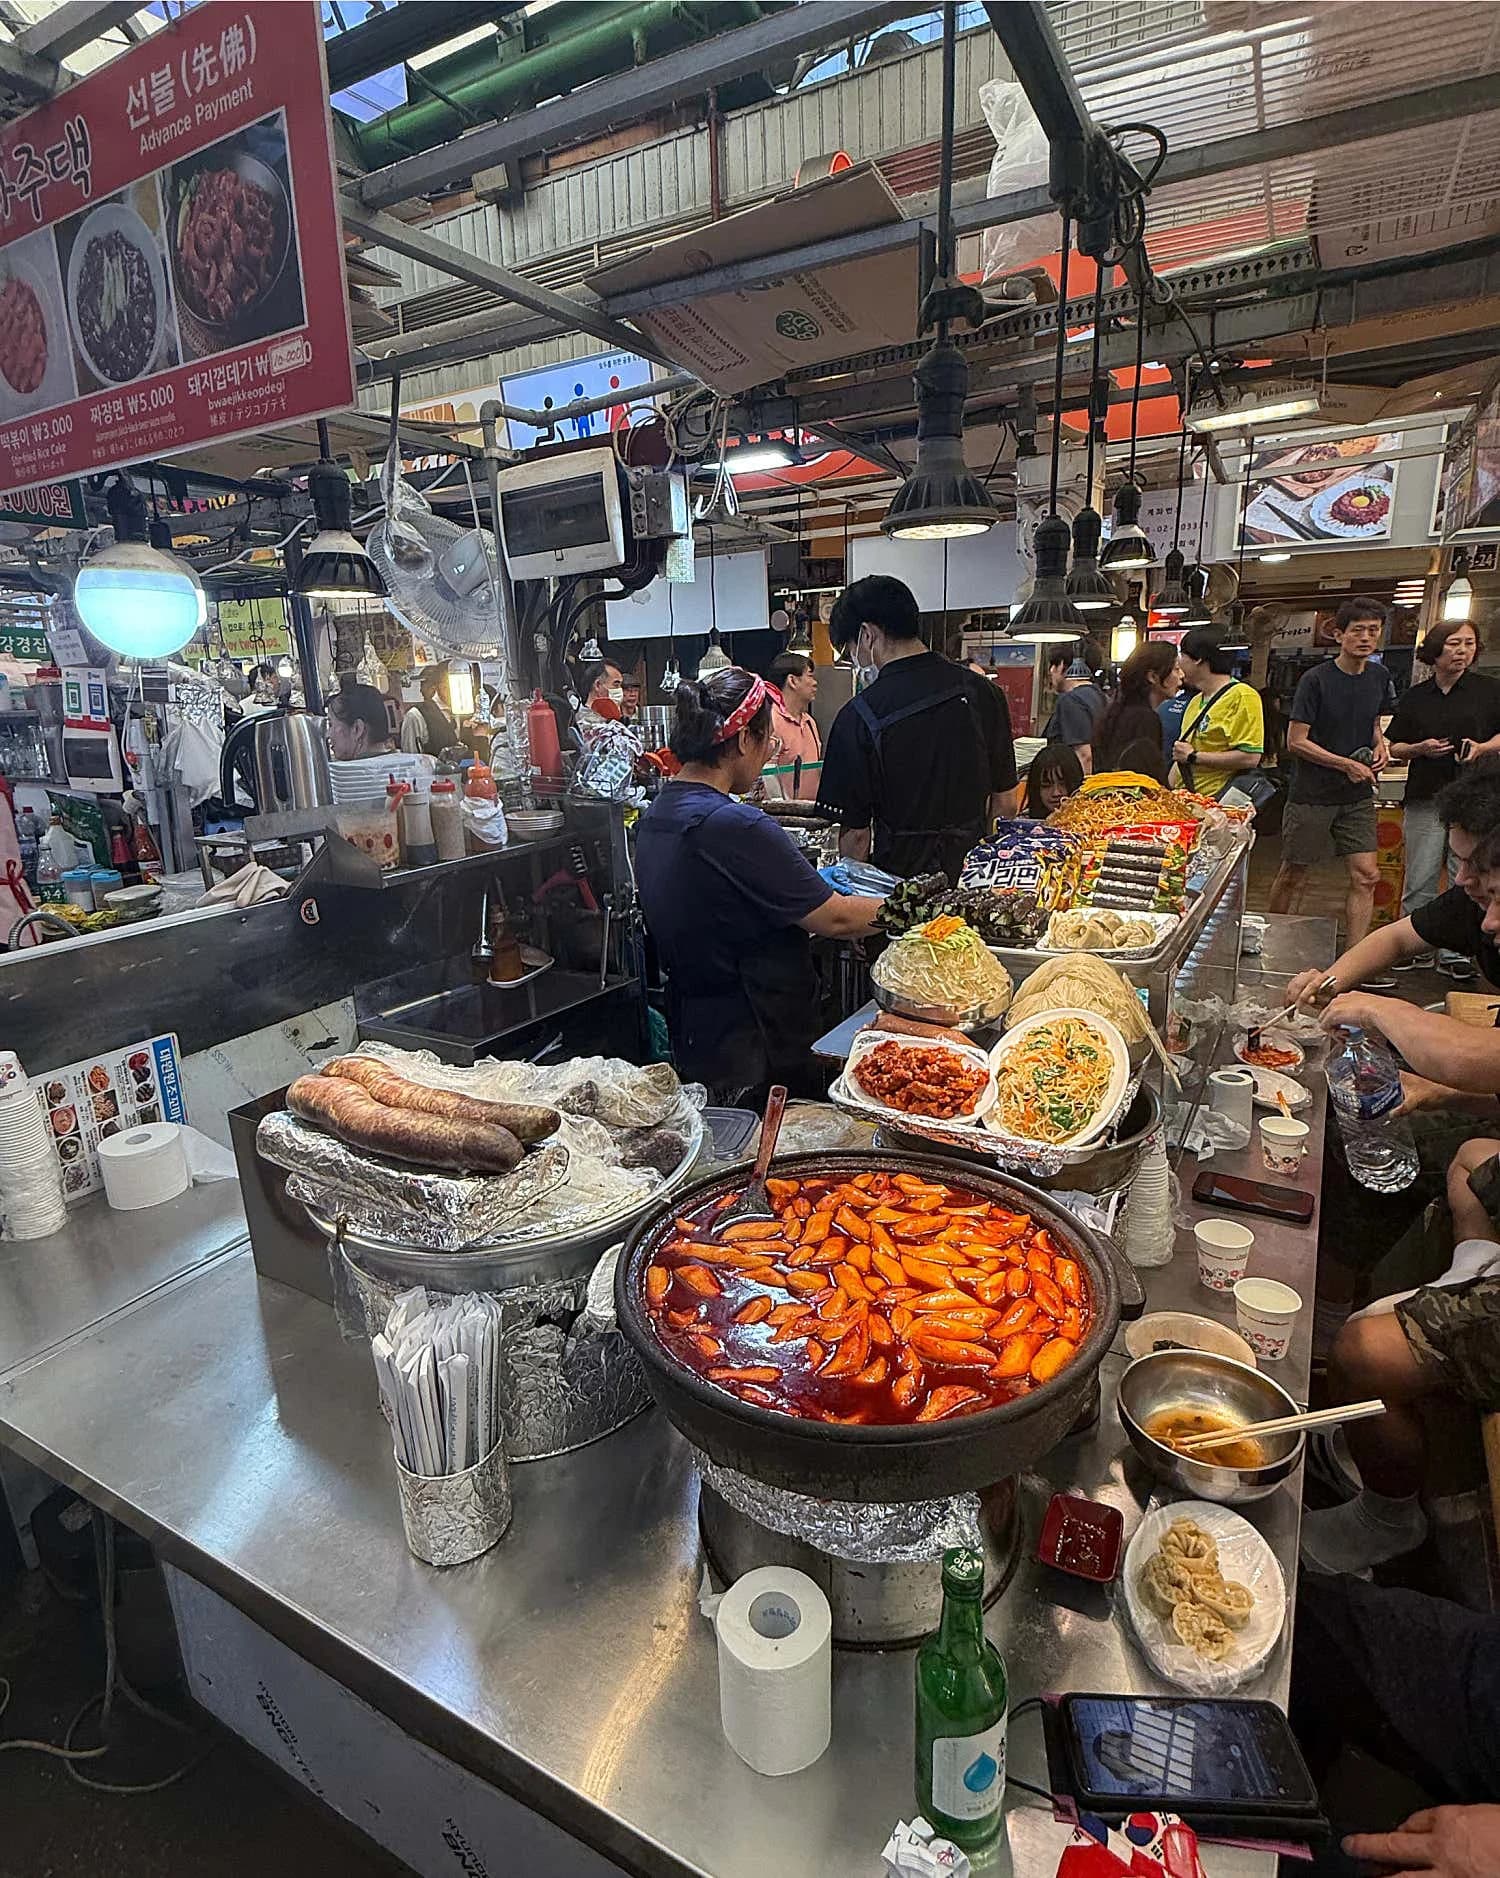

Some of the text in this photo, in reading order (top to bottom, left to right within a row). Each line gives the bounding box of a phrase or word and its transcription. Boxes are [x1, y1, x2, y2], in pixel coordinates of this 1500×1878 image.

[140, 77, 254, 155] Advance Payment
[0, 114, 92, 222] 주댁
[188, 356, 253, 397] 돼지껍데기
[91, 398, 125, 427] 짜장면
